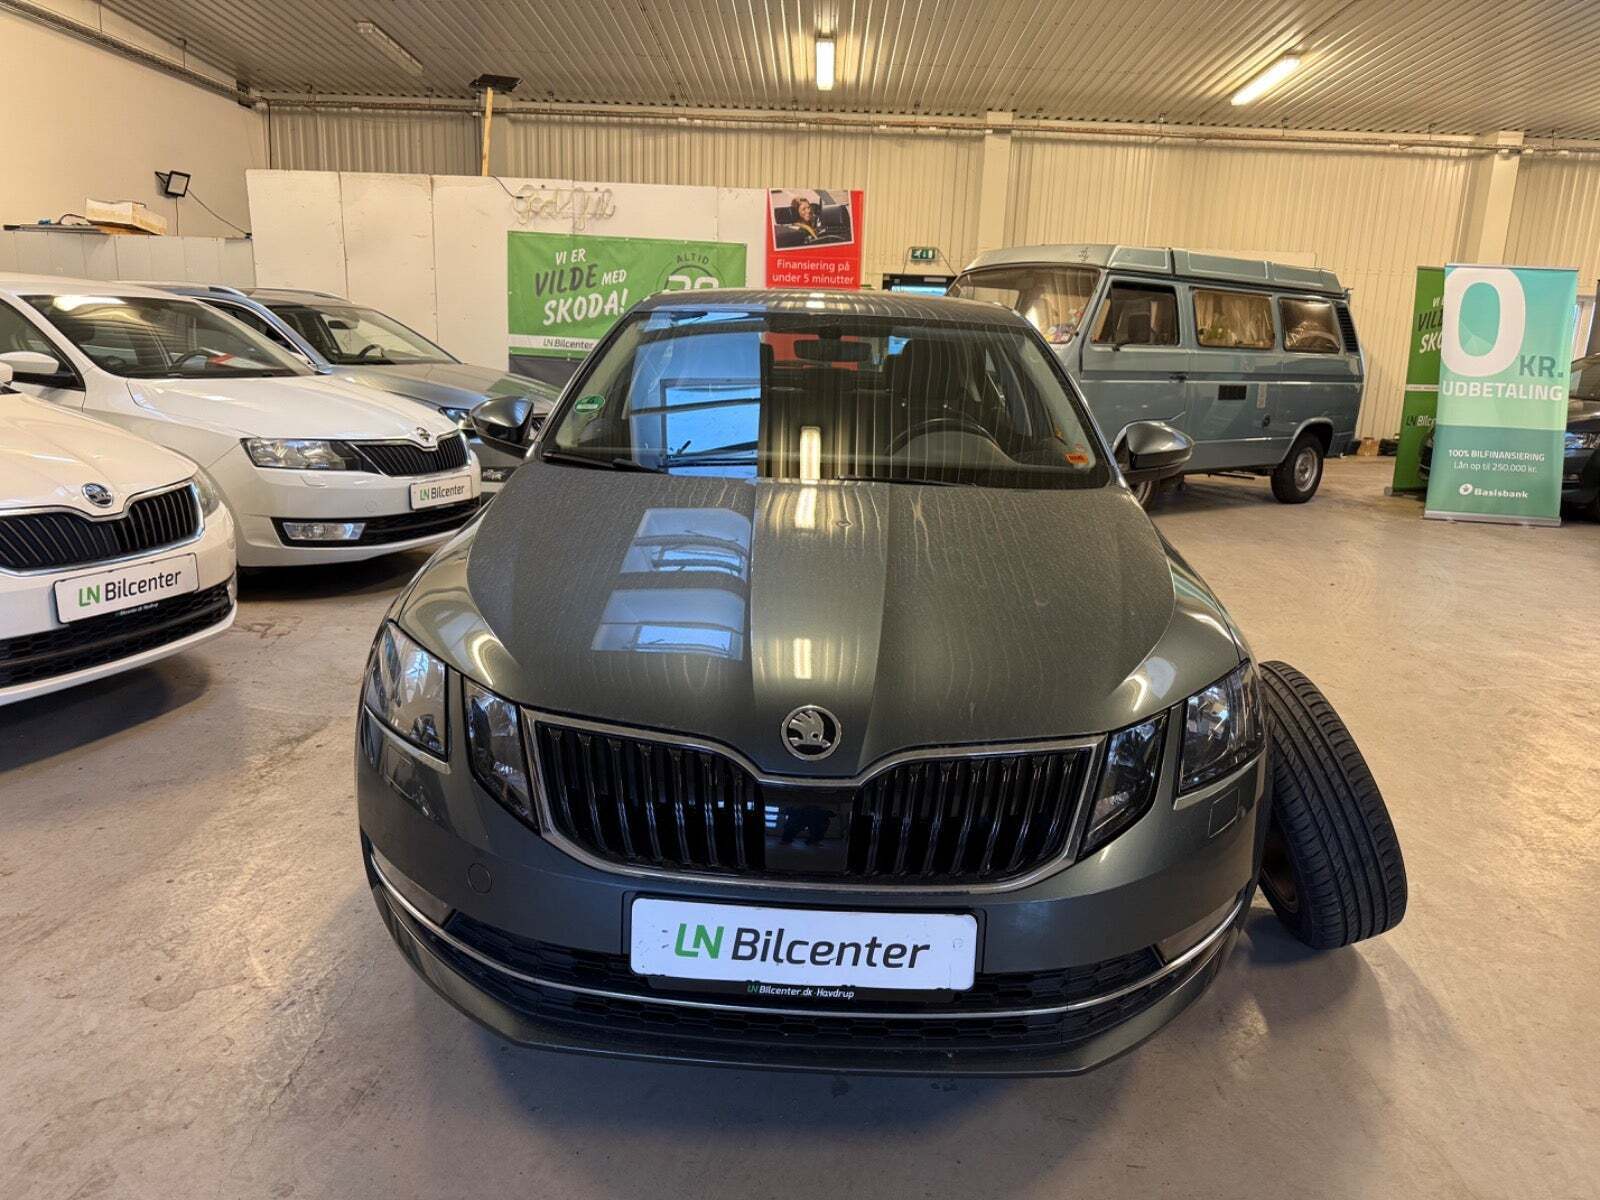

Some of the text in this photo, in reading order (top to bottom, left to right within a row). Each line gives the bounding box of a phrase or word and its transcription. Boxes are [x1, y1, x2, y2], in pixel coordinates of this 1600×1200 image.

[555, 248, 587, 265] VI ER
[676, 253, 709, 265] ALTID
[776, 259, 850, 272] Finansiering på
[535, 263, 627, 297] VILDE MED
[772, 273, 854, 285] under 5 minutter
[542, 288, 629, 326] SKODA!
[1519, 354, 1564, 378] KR.
[1442, 380, 1563, 401] UDBETALING
[1448, 449, 1545, 461] 100% BILFINANSIERING
[1454, 461, 1468, 469] Lån
[1470, 463, 1481, 472] op
[1482, 463, 1490, 471] til
[1492, 463, 1526, 472] 250.000
[1474, 488, 1528, 498] Basisbank
[105, 571, 182, 601] Bilcenter
[731, 927, 930, 969] Bilcenter
[816, 988, 855, 1000] Havdrup
